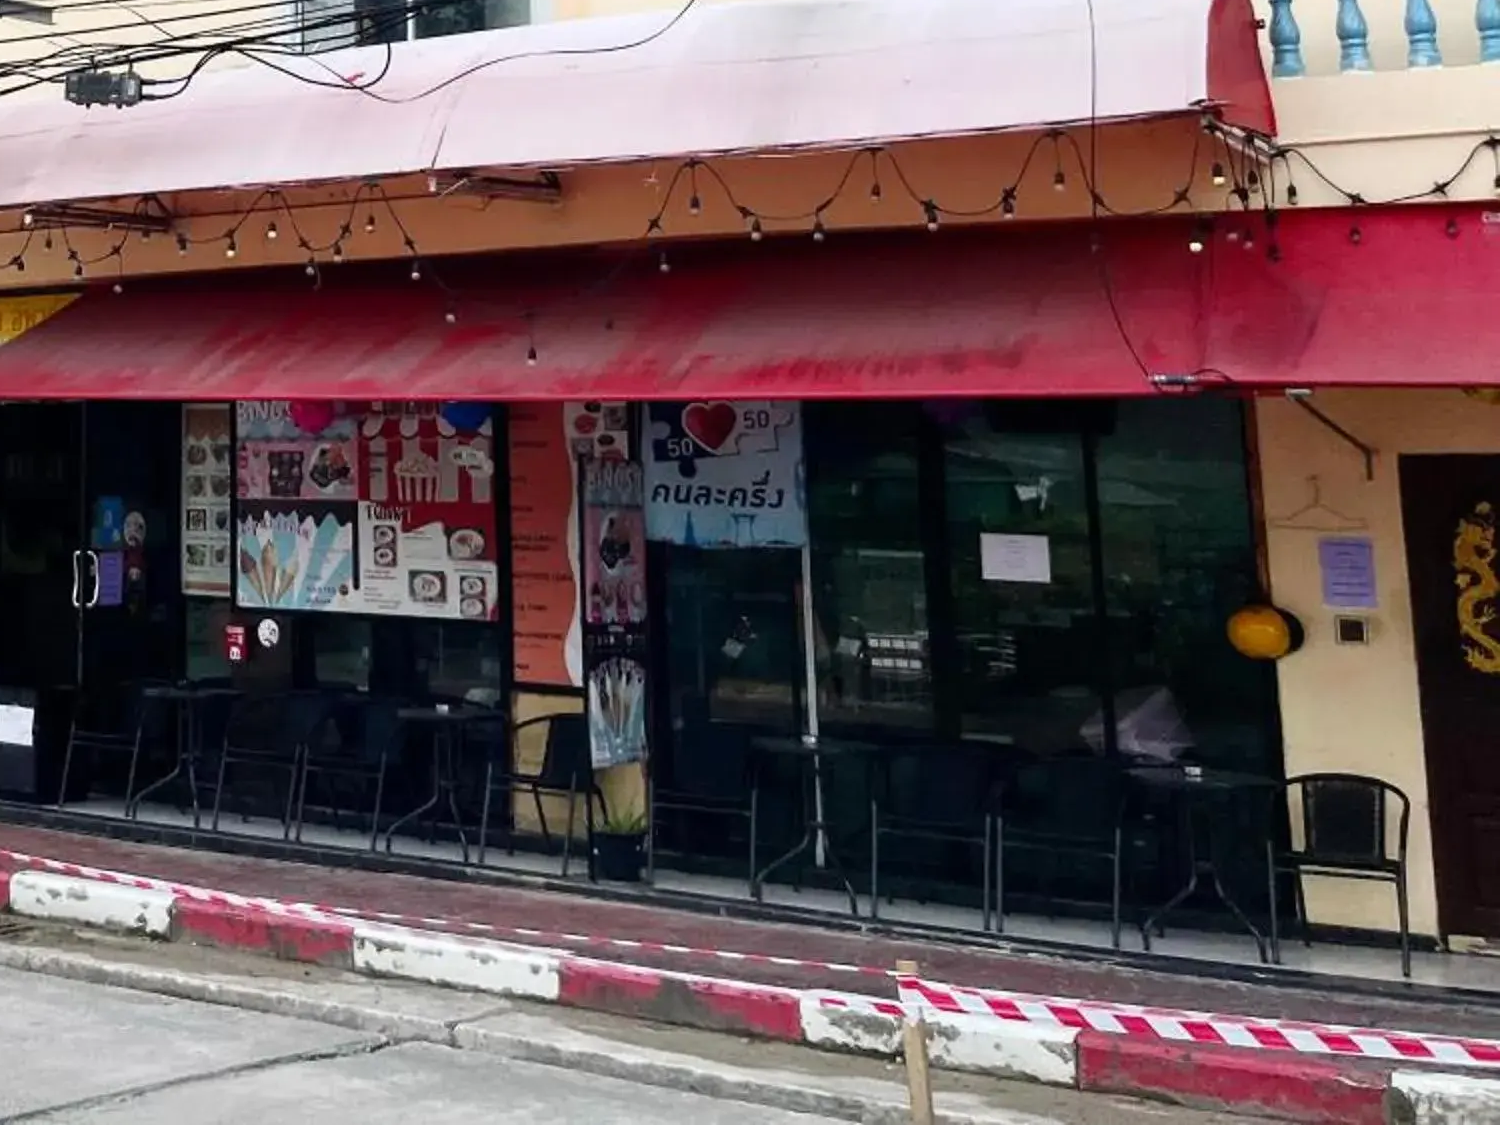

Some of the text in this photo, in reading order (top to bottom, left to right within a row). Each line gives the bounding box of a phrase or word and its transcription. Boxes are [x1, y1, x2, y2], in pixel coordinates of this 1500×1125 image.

[743, 409, 770, 429] 50
[667, 438, 694, 457] 50
[651, 470, 785, 509] คนละครึ่ง
